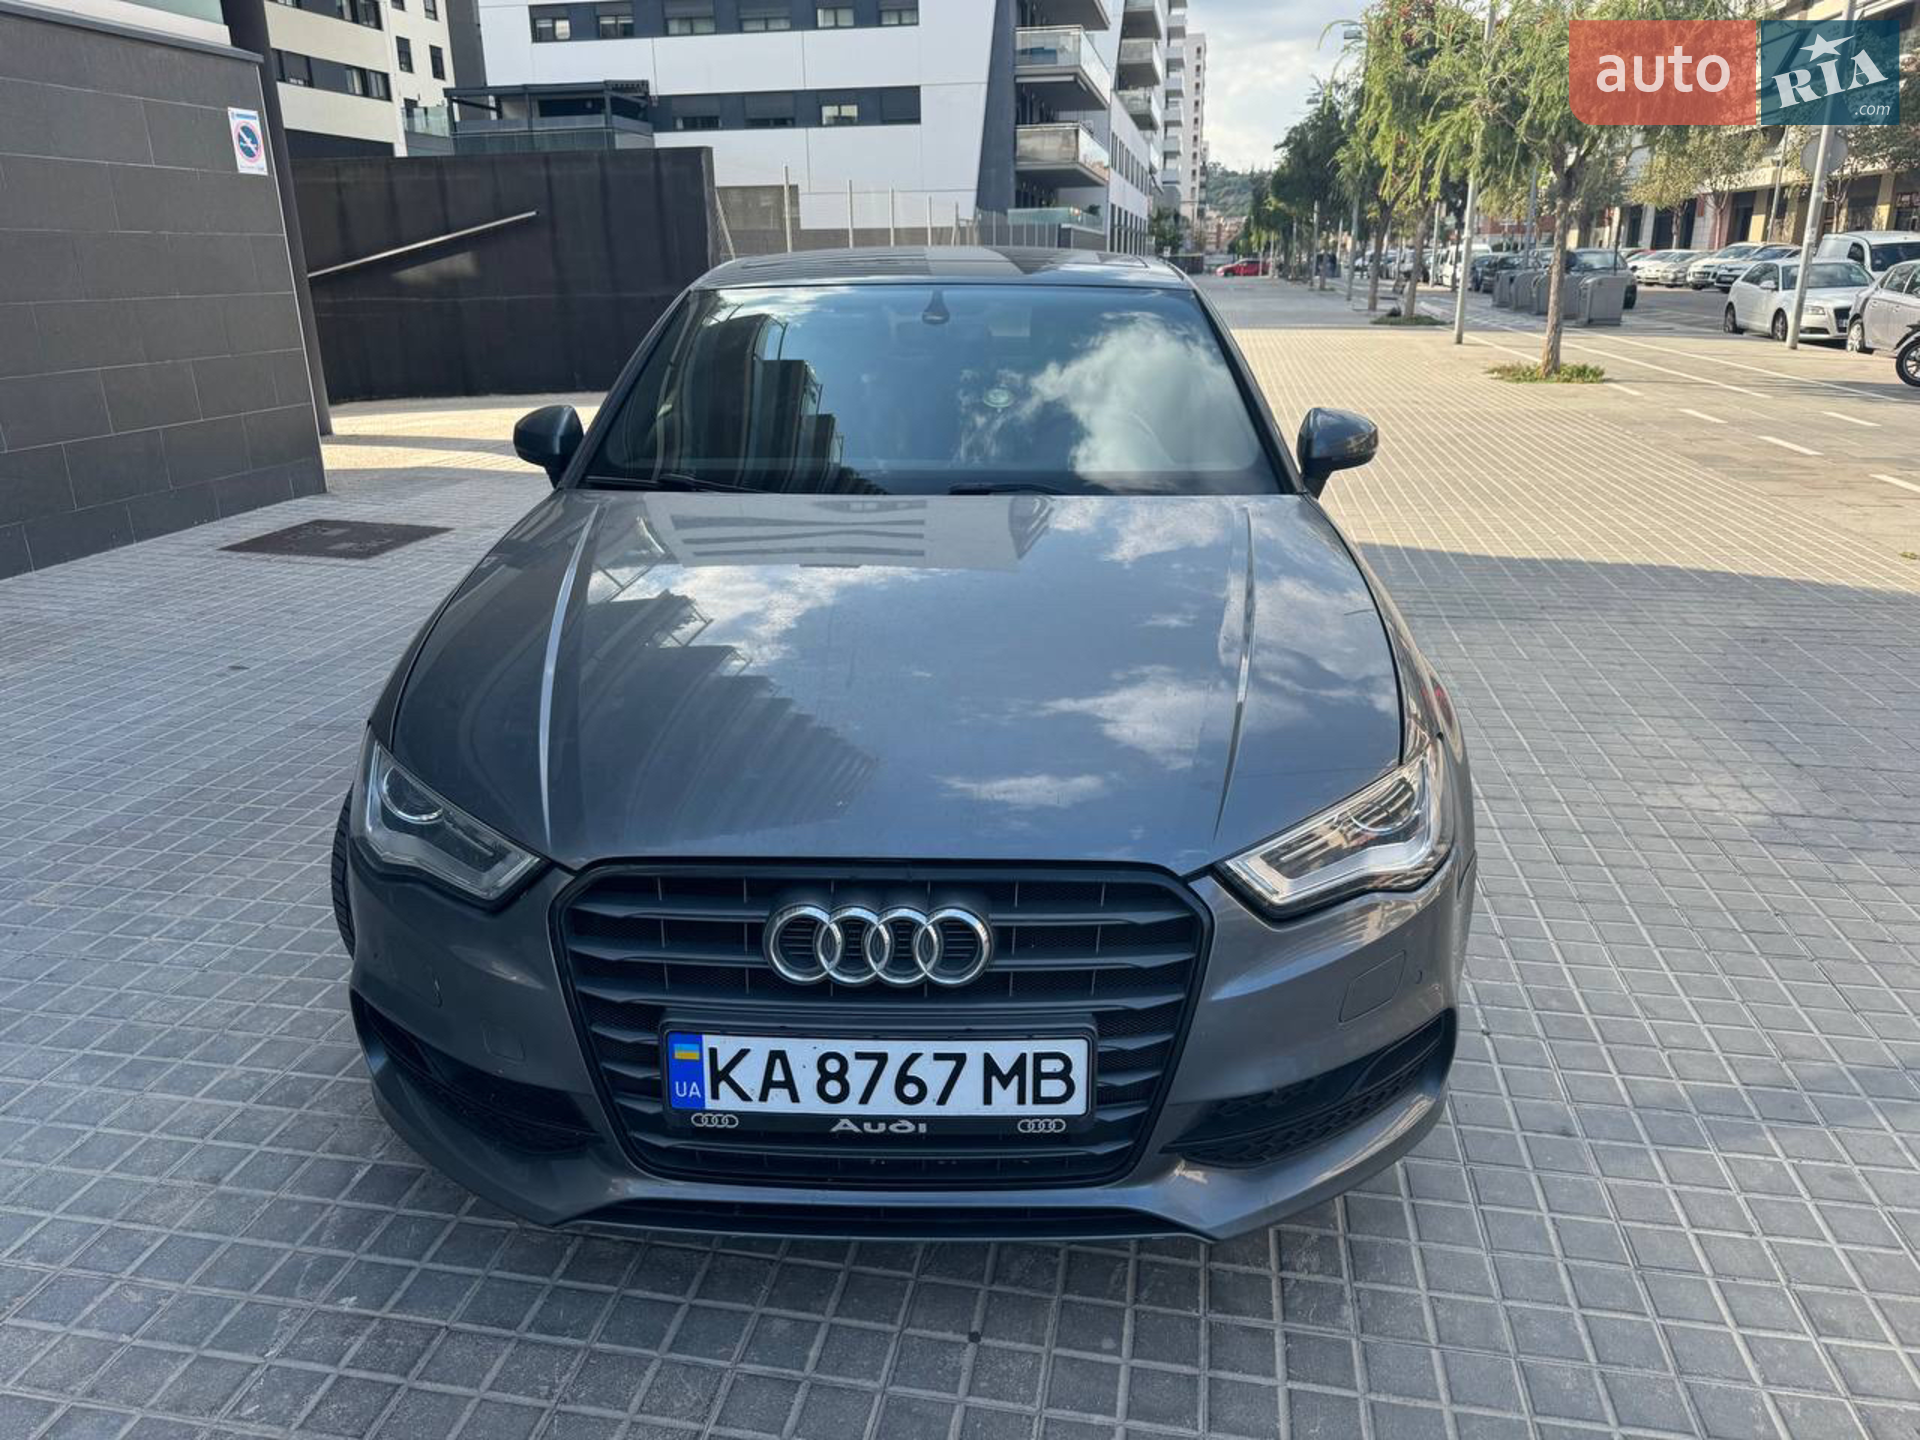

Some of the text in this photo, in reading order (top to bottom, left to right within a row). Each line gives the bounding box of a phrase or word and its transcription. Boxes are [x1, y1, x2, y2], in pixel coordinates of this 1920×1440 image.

[675, 1080, 701, 1098] UA
[708, 1046, 1077, 1106] KA 8767 MB
